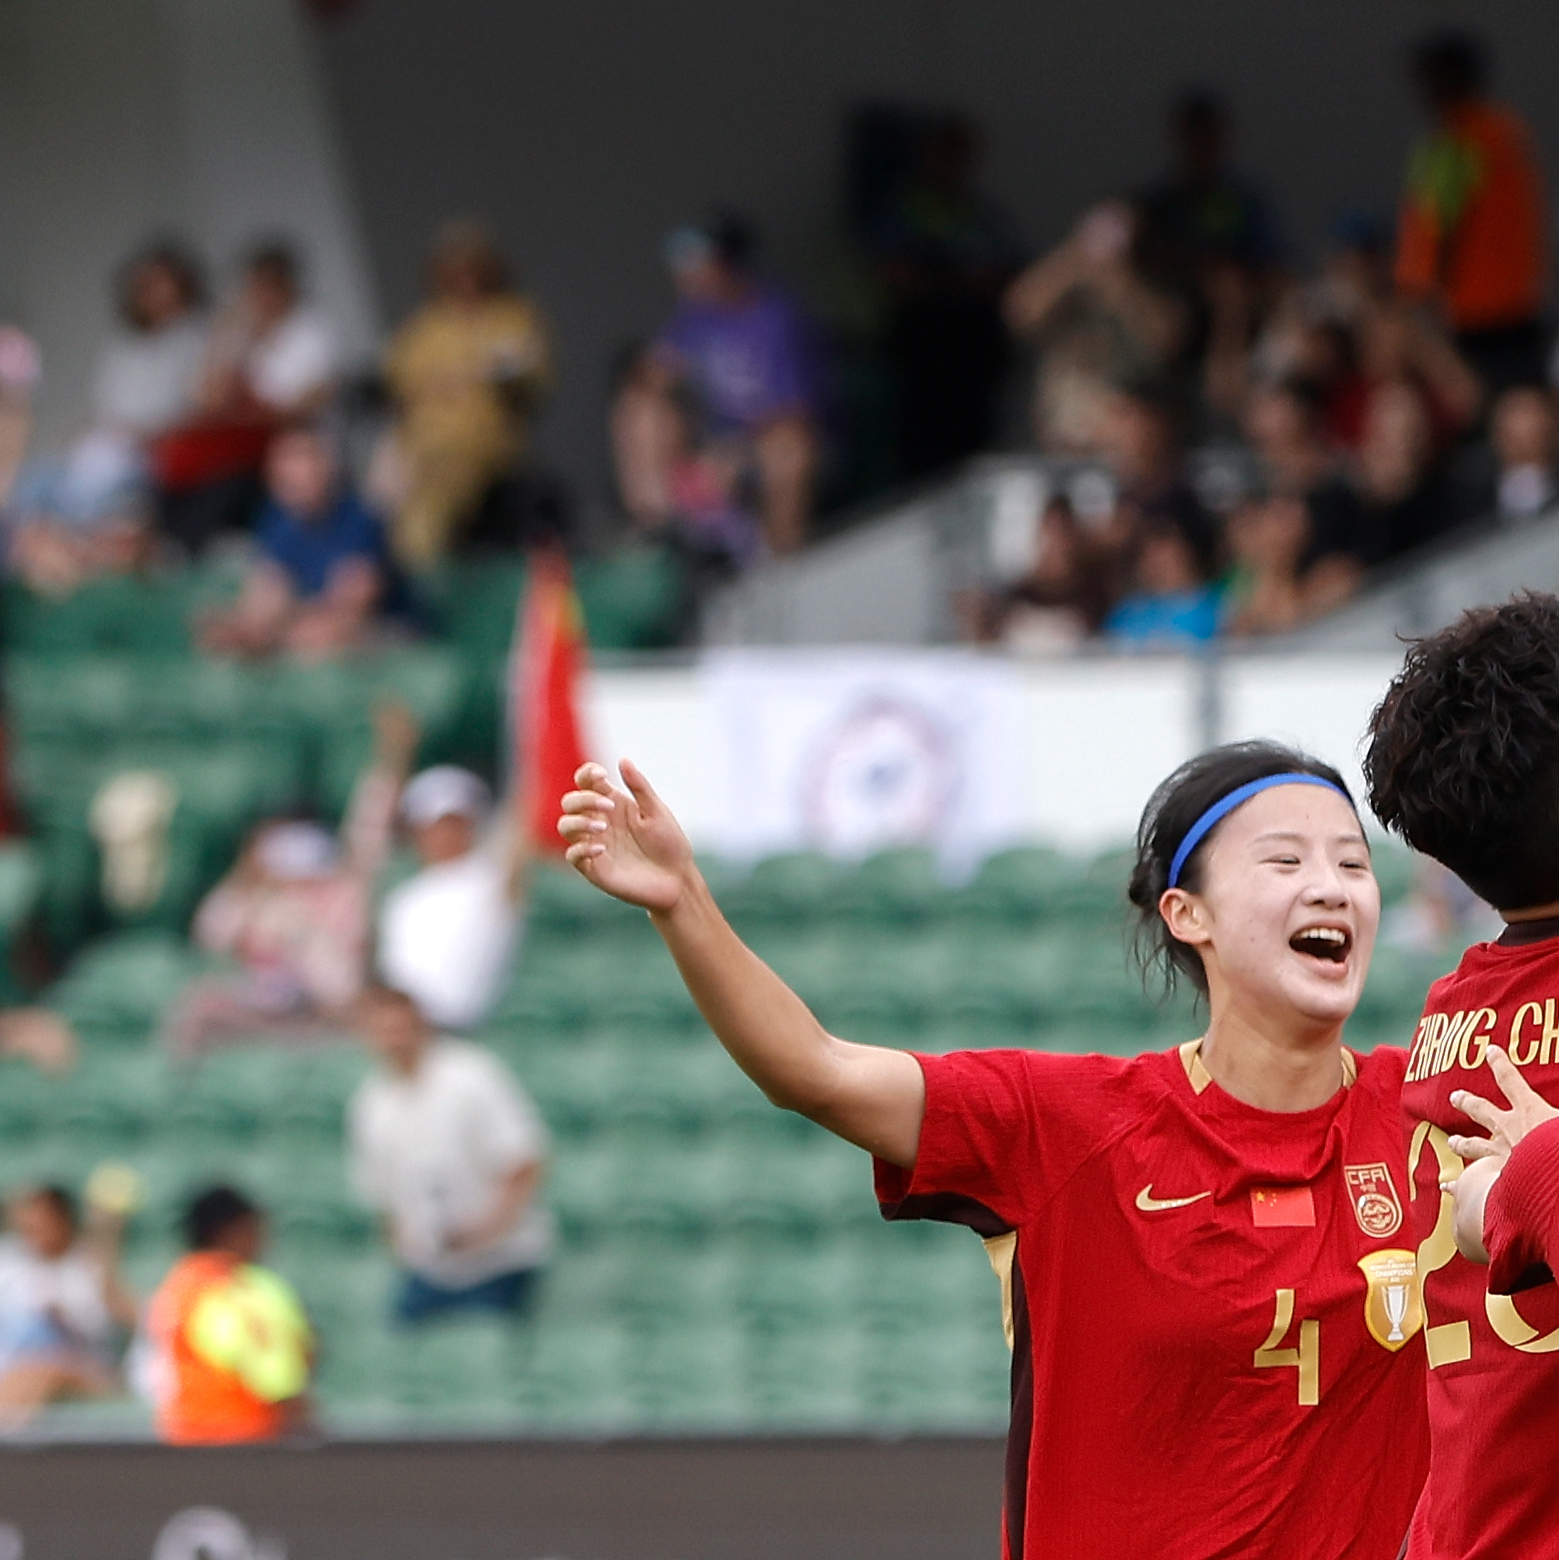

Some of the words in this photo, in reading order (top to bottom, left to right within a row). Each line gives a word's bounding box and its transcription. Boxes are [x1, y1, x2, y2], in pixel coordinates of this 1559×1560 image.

[1403, 1006, 1499, 1084] ZHANG
[1346, 1169, 1385, 1185] CFA
[1252, 1288, 1321, 1407] 4
